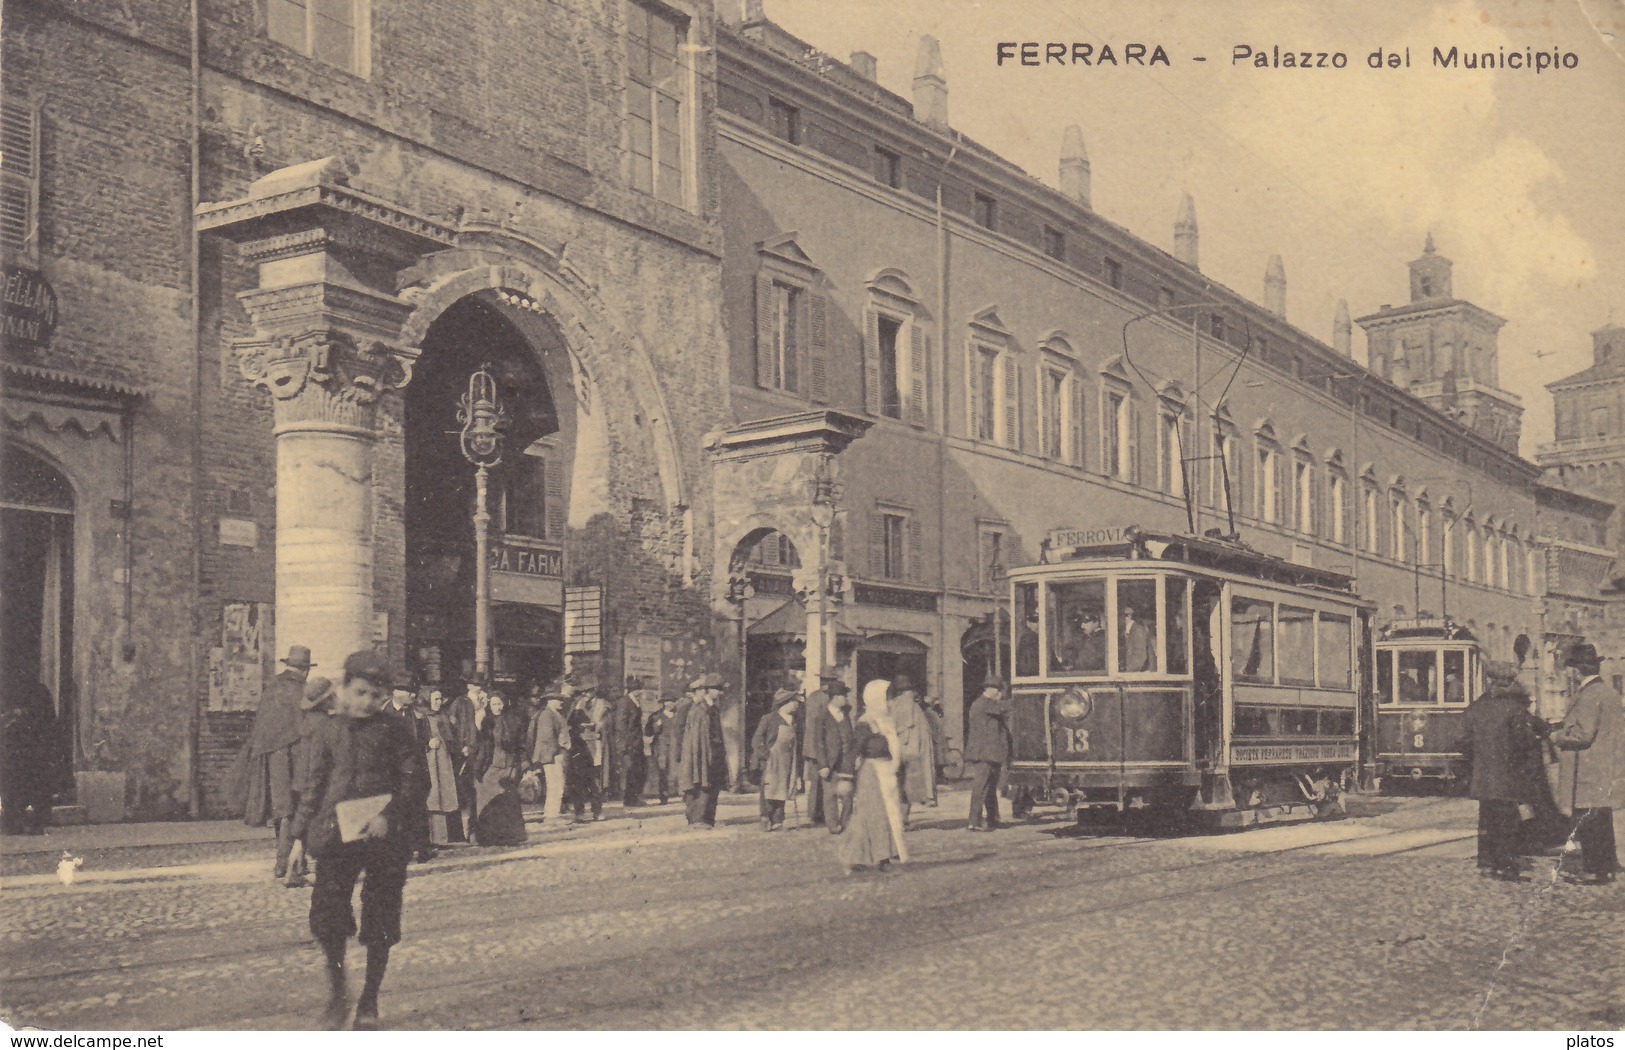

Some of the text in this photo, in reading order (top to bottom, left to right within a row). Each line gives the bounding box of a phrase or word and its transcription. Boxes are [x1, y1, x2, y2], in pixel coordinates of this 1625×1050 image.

[1057, 528, 1129, 546] FERROVI
[518, 551, 562, 575] FARM
[1064, 727, 1089, 752] 13
[1413, 734, 1425, 748] 8
